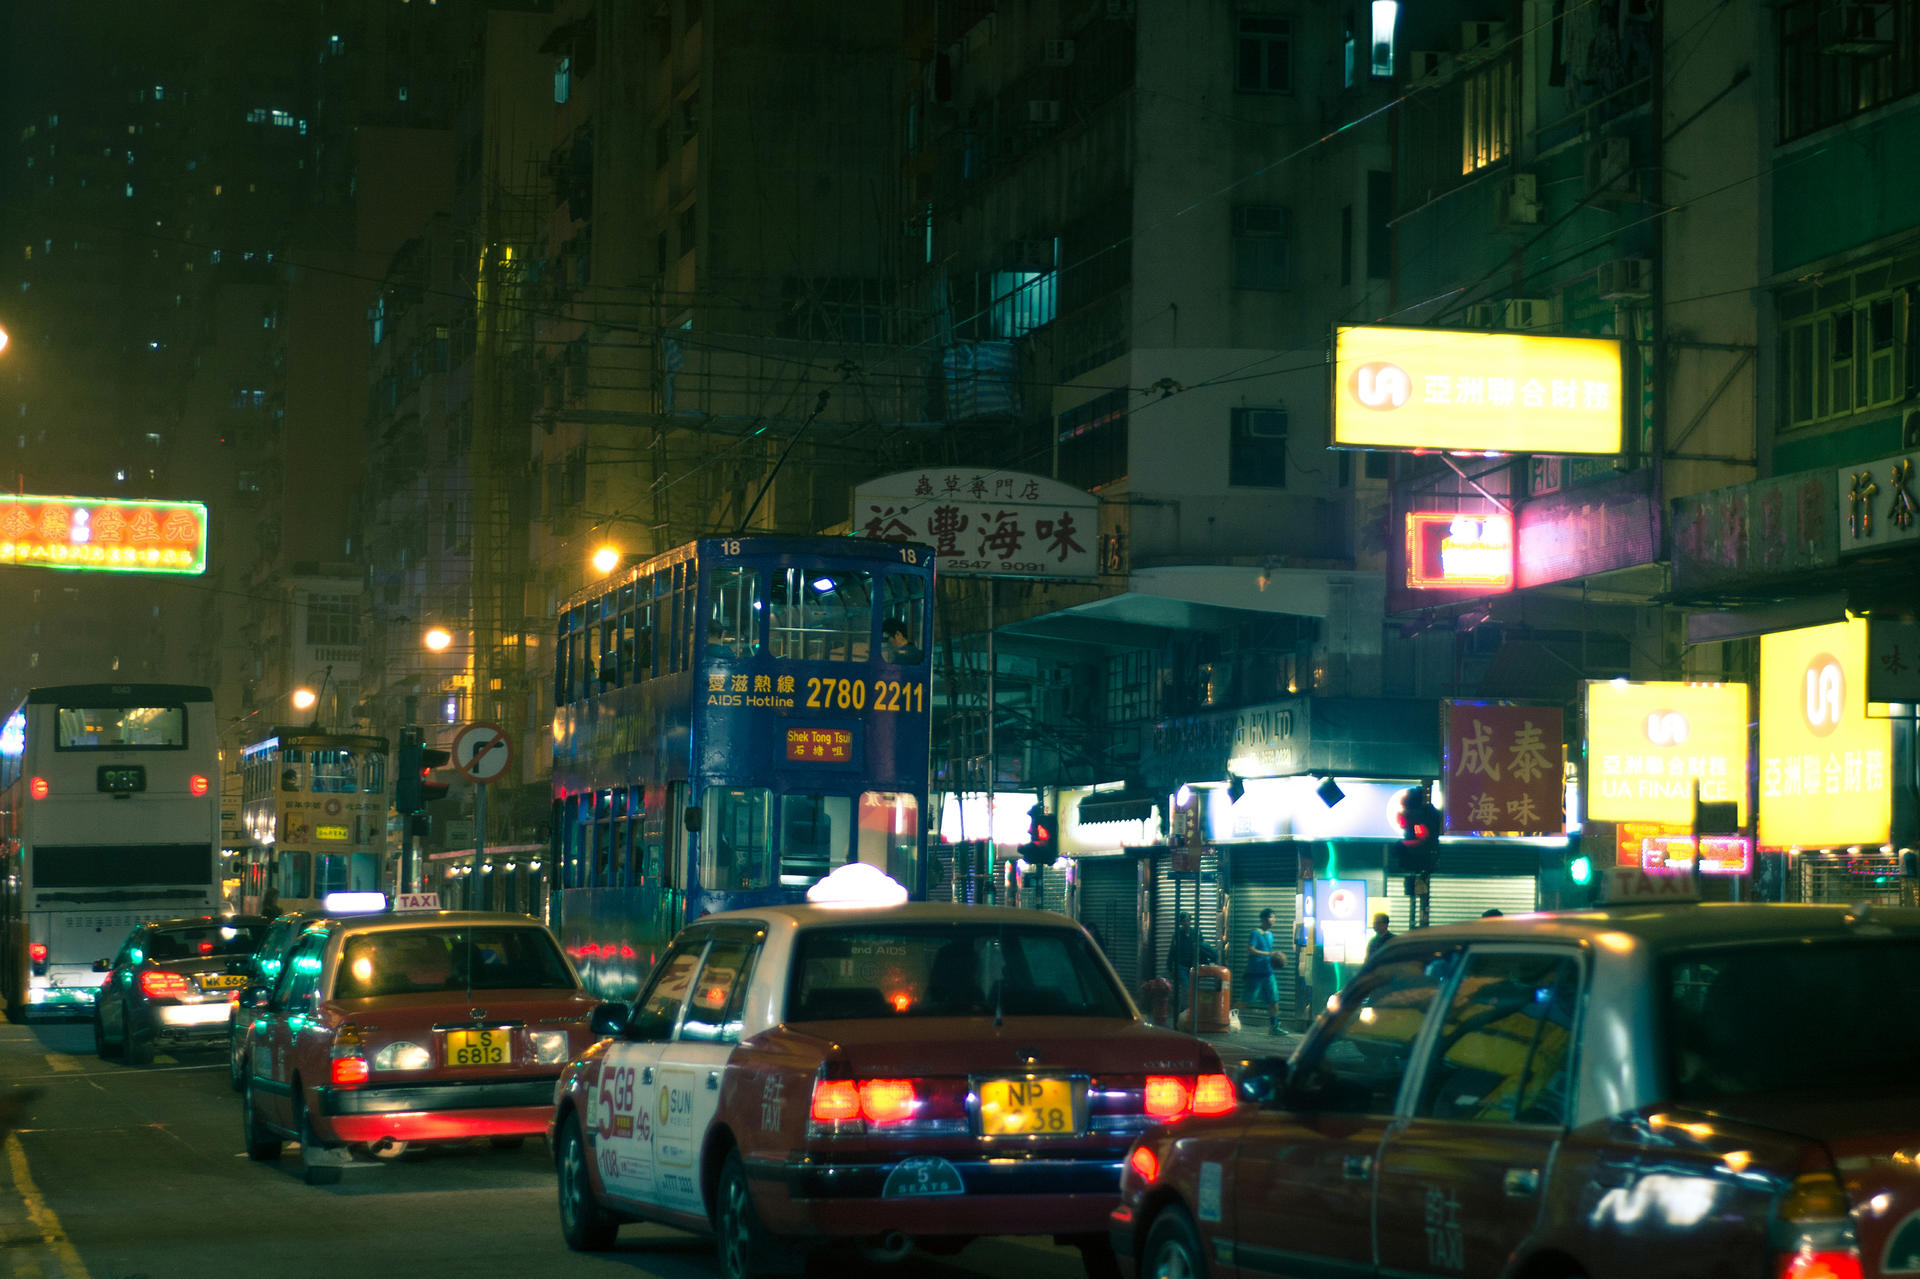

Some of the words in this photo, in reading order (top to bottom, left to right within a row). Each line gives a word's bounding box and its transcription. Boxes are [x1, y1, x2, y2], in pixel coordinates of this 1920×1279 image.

[1423, 375, 1610, 410] 亞洲聯合財務
[915, 474, 1041, 501] 蟲草專門店
[865, 505, 1087, 563] 裕豐海味
[721, 540, 741, 556] 18
[899, 548, 917, 564] 18
[948, 559, 991, 570] 2547
[1001, 561, 1046, 572] 9091
[707, 674, 796, 693] 愛滋熱線
[707, 694, 742, 707] AIDS
[746, 694, 794, 708] Hotline
[806, 678, 866, 710] 2780
[873, 681, 923, 713] 2211
[787, 730, 809, 743] Shek
[812, 732, 832, 745] Tong
[834, 733, 852, 745] Tsui
[794, 746, 844, 758] 石塘咀
[1602, 754, 1728, 777] 亞洲聯合財務
[1764, 748, 1885, 797] 亞洲聯合財務
[1602, 780, 1634, 798] UA
[1638, 780, 1729, 800] FINACE
[1467, 791, 1540, 827] 海味
[1616, 871, 1692, 897] TAXI
[399, 893, 438, 908] TAXI
[876, 945, 906, 956] AIDS
[466, 1032, 492, 1048] LS
[457, 1047, 502, 1064] 6813
[670, 1088, 691, 1114] SUN
[1008, 1084, 1044, 1106] NP
[760, 1103, 782, 1132] TAXI
[917, 1166, 929, 1183] 5
[898, 1182, 950, 1194] SEATS
[1425, 1228, 1465, 1270] TAXI
